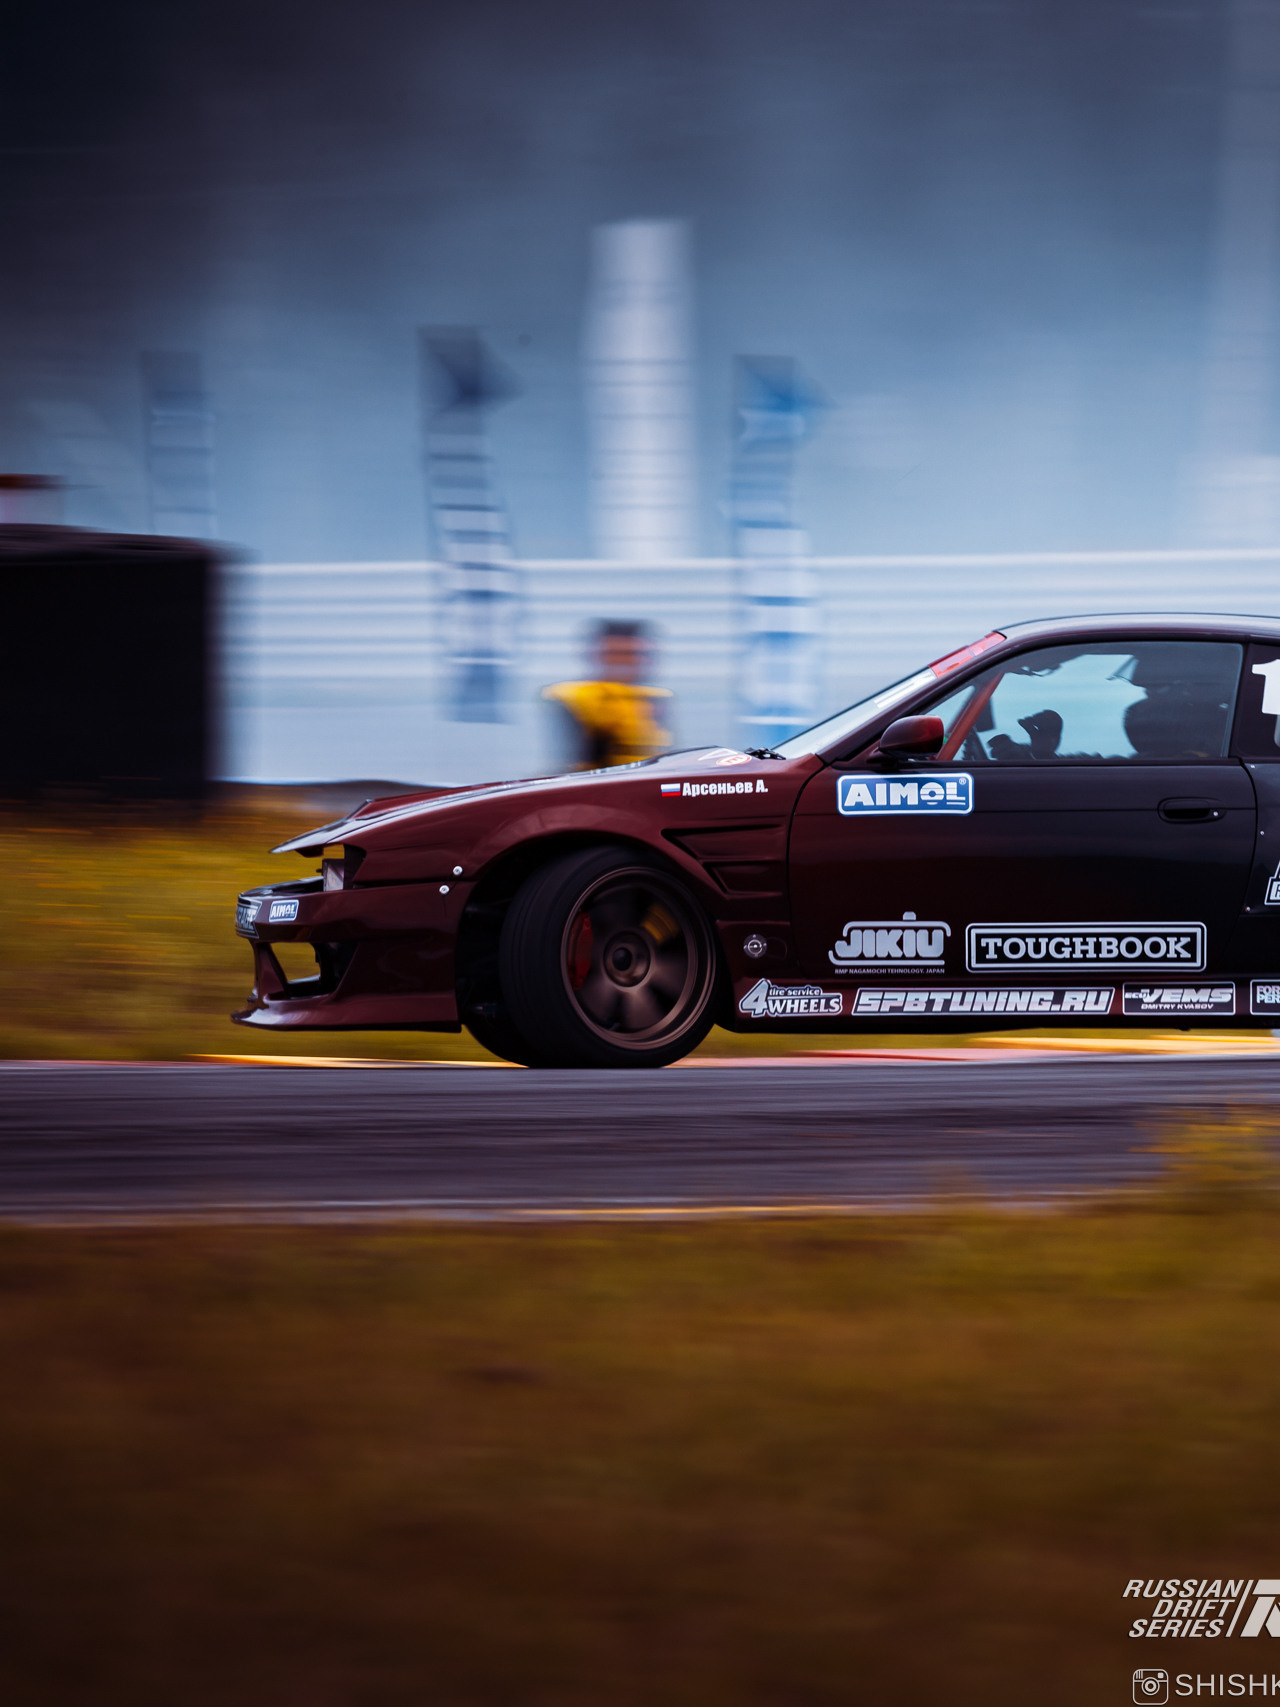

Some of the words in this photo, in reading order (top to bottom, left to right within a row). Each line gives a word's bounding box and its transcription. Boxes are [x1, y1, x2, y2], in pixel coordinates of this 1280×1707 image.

[682, 781, 754, 797] Арсеньев
[755, 779, 769, 793] А.
[844, 782, 966, 806] AIMOL
[834, 927, 945, 959] JIKIU
[980, 936, 1192, 960] TOUGHBOOK
[742, 980, 769, 1015] 4
[769, 987, 785, 996] tire
[787, 987, 820, 996] service
[856, 991, 1111, 1012] SPBTUNING.RU
[1141, 988, 1233, 1003] VEMS
[768, 998, 840, 1013] WHEELS
